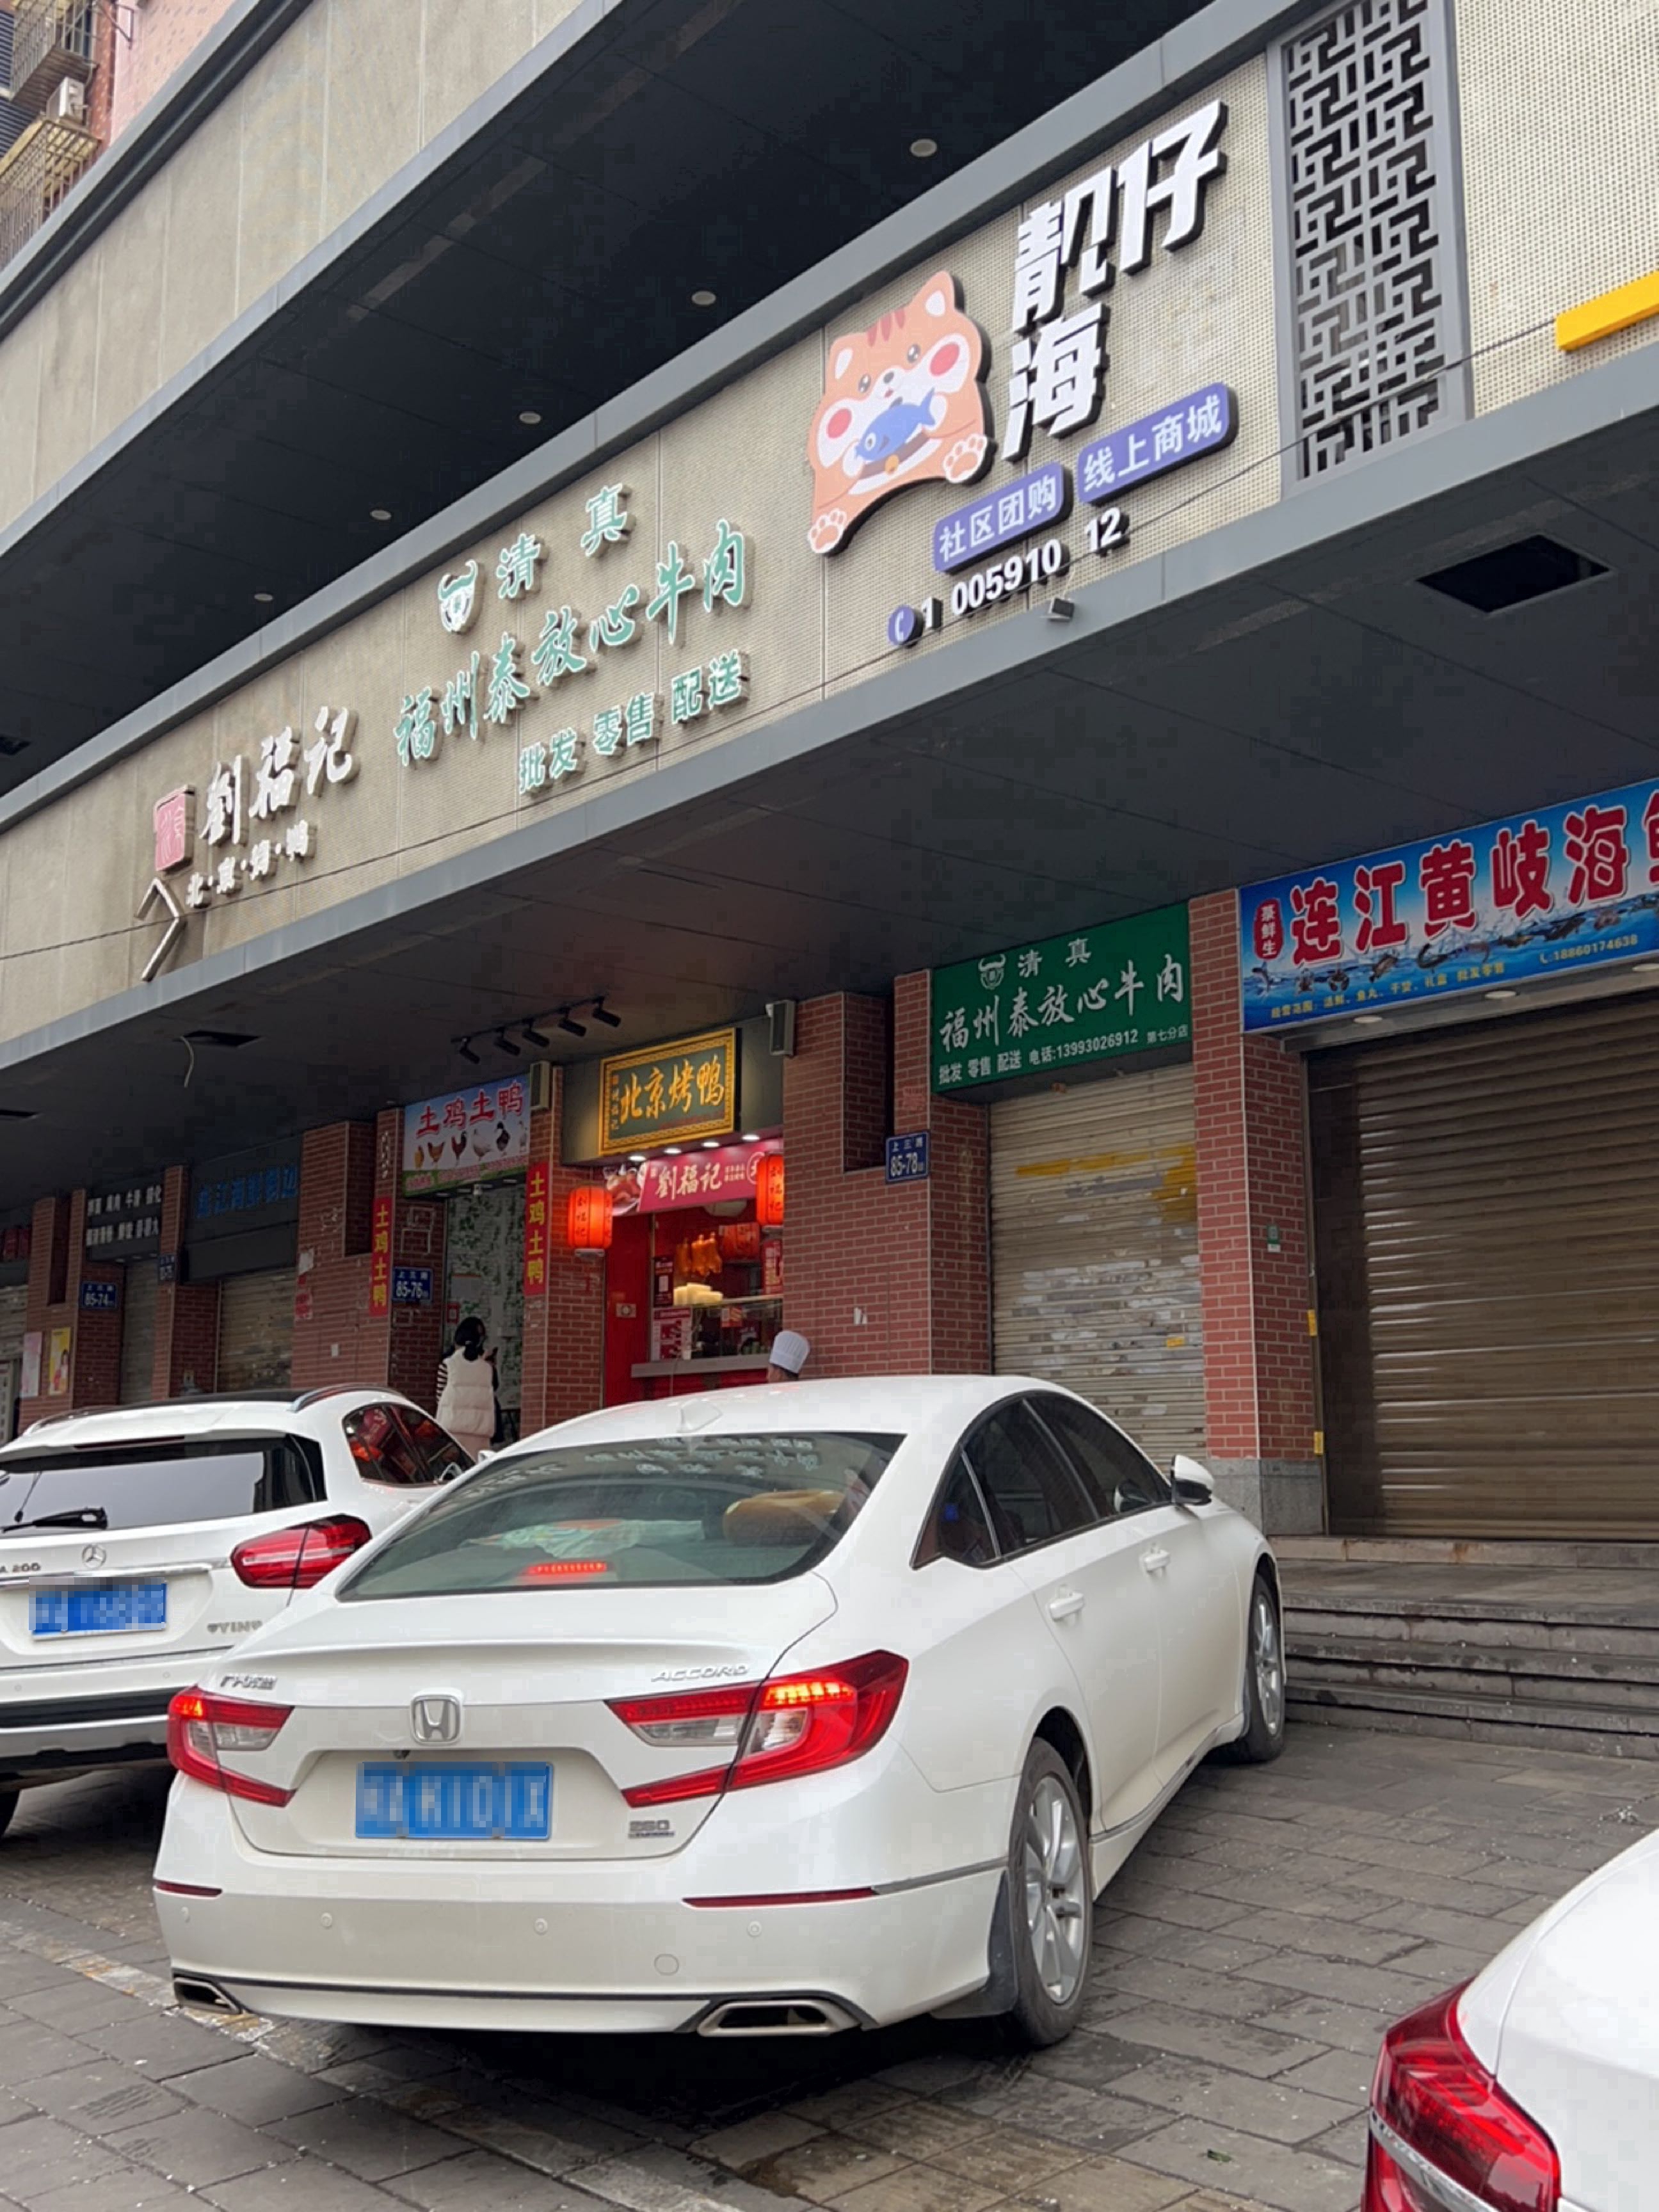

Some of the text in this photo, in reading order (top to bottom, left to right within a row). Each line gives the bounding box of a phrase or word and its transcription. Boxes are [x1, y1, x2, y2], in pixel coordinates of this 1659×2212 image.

[1013, 100, 1224, 332] 靓仔
[1002, 303, 1107, 460] 海
[1083, 395, 1223, 494] 线上商城
[496, 483, 629, 598] 清真
[938, 476, 1057, 561] 社区团购
[952, 539, 1062, 616] 005910
[1086, 508, 1123, 552] 12
[394, 518, 744, 766] 福州泰放心牛肉
[519, 648, 742, 795] 批发 零售 配送
[1290, 790, 1659, 965] 连江黄岐海
[939, 954, 1184, 1052] 福州泰放心牛肉
[1018, 938, 1092, 978] 清真
[417, 1080, 524, 1138] 土鸡土鸭
[939, 1063, 962, 1085] 批发
[968, 1056, 991, 1077] 零售
[997, 1050, 1022, 1073] 配送
[373, 1204, 389, 1307] 土鸡土鸭
[527, 1171, 545, 1284] 土鸡土鸭
[651, 1663, 748, 1683] ACCORD
